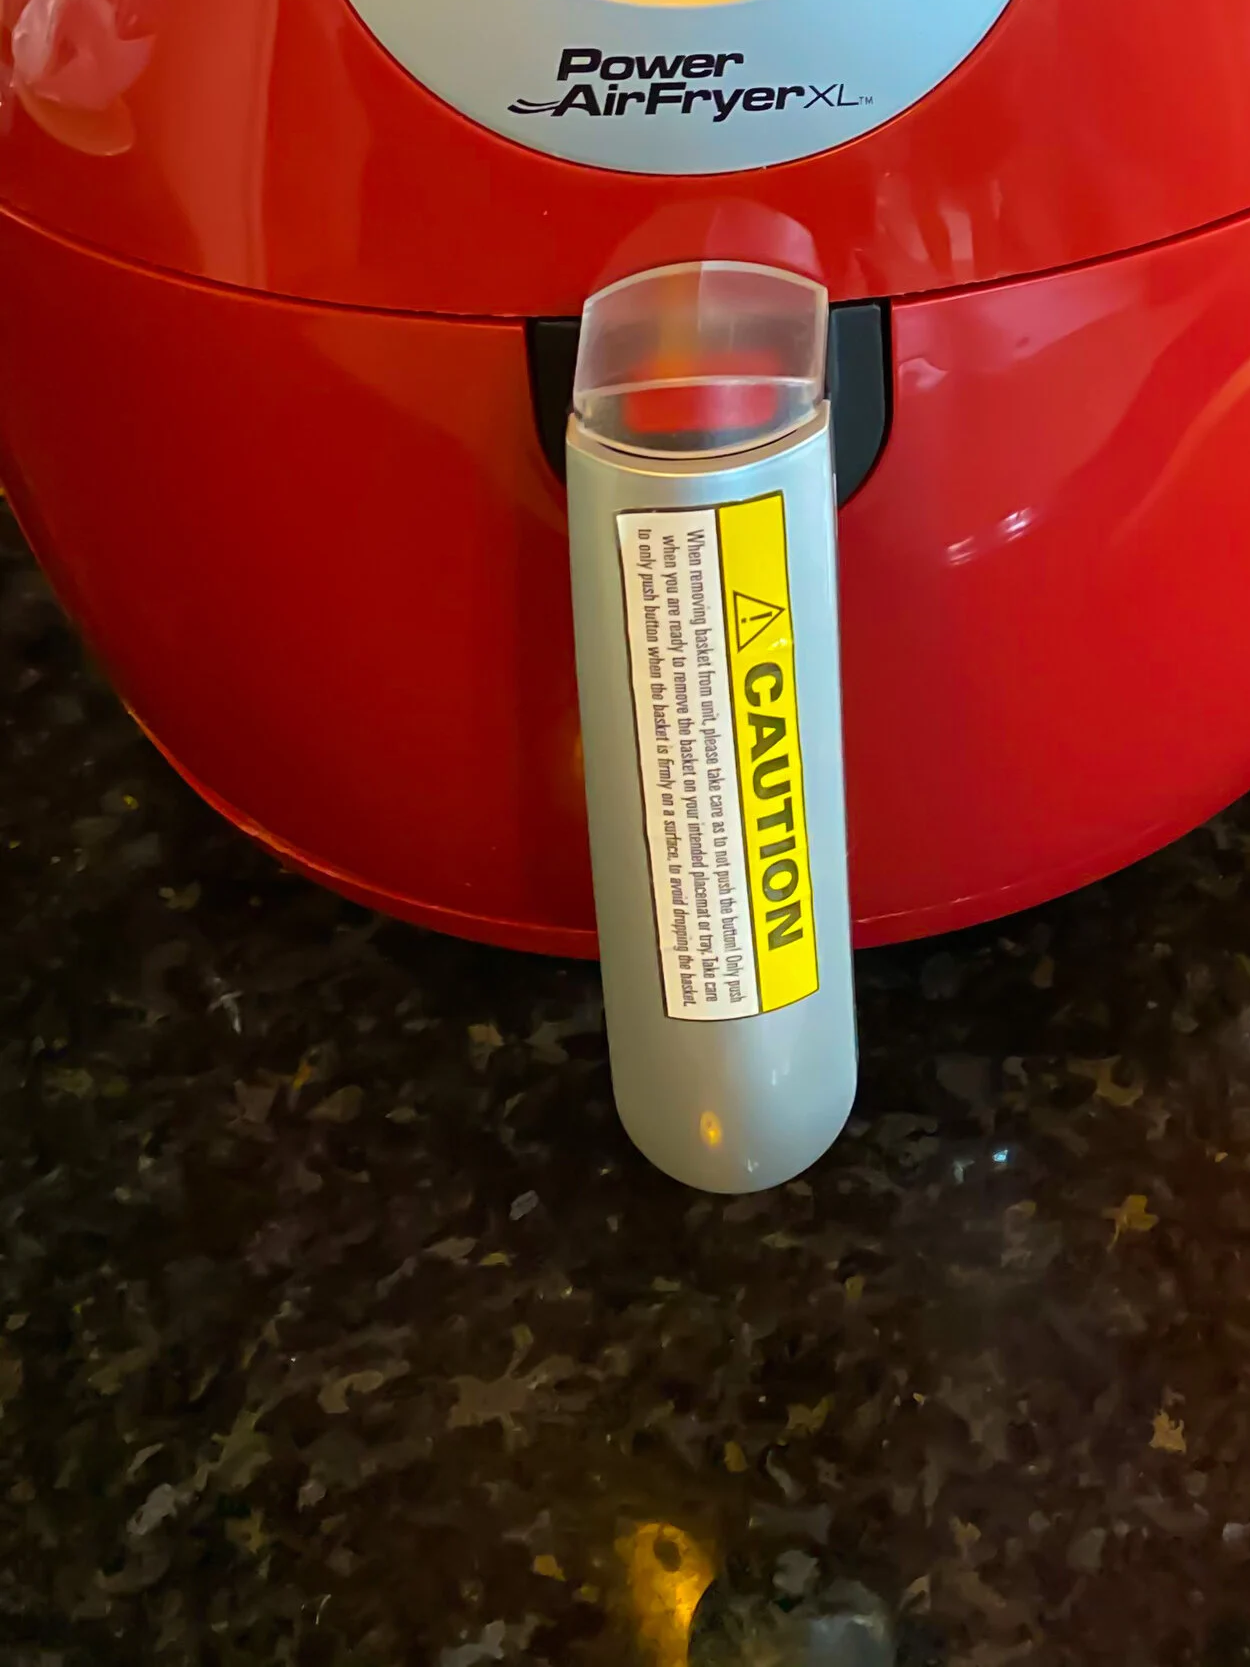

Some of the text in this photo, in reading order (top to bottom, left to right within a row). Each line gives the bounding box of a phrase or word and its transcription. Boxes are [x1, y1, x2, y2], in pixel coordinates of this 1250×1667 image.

[557, 48, 744, 81] Power
[638, 529, 652, 539] to
[636, 545, 656, 570] only
[638, 574, 659, 601] push
[644, 606, 660, 642] button
[647, 647, 664, 678] when
[650, 683, 667, 700] the
[652, 704, 671, 741] basket
[657, 745, 673, 754] is
[656, 758, 676, 790] firmly
[661, 535, 719, 1002] when you are ready to remove the basket on your intended placemat or tray. Take care
[687, 529, 747, 1003] When removing basket from unit, please take care as to not push the button! Only push
[662, 794, 674, 806] on
[745, 661, 803, 951] CAUTION
[663, 820, 681, 861] surface,
[669, 865, 682, 874] to
[670, 878, 688, 905] avoid
[671, 909, 692, 951] dropping
[678, 955, 693, 969] the
[680, 973, 697, 1007] basket.
